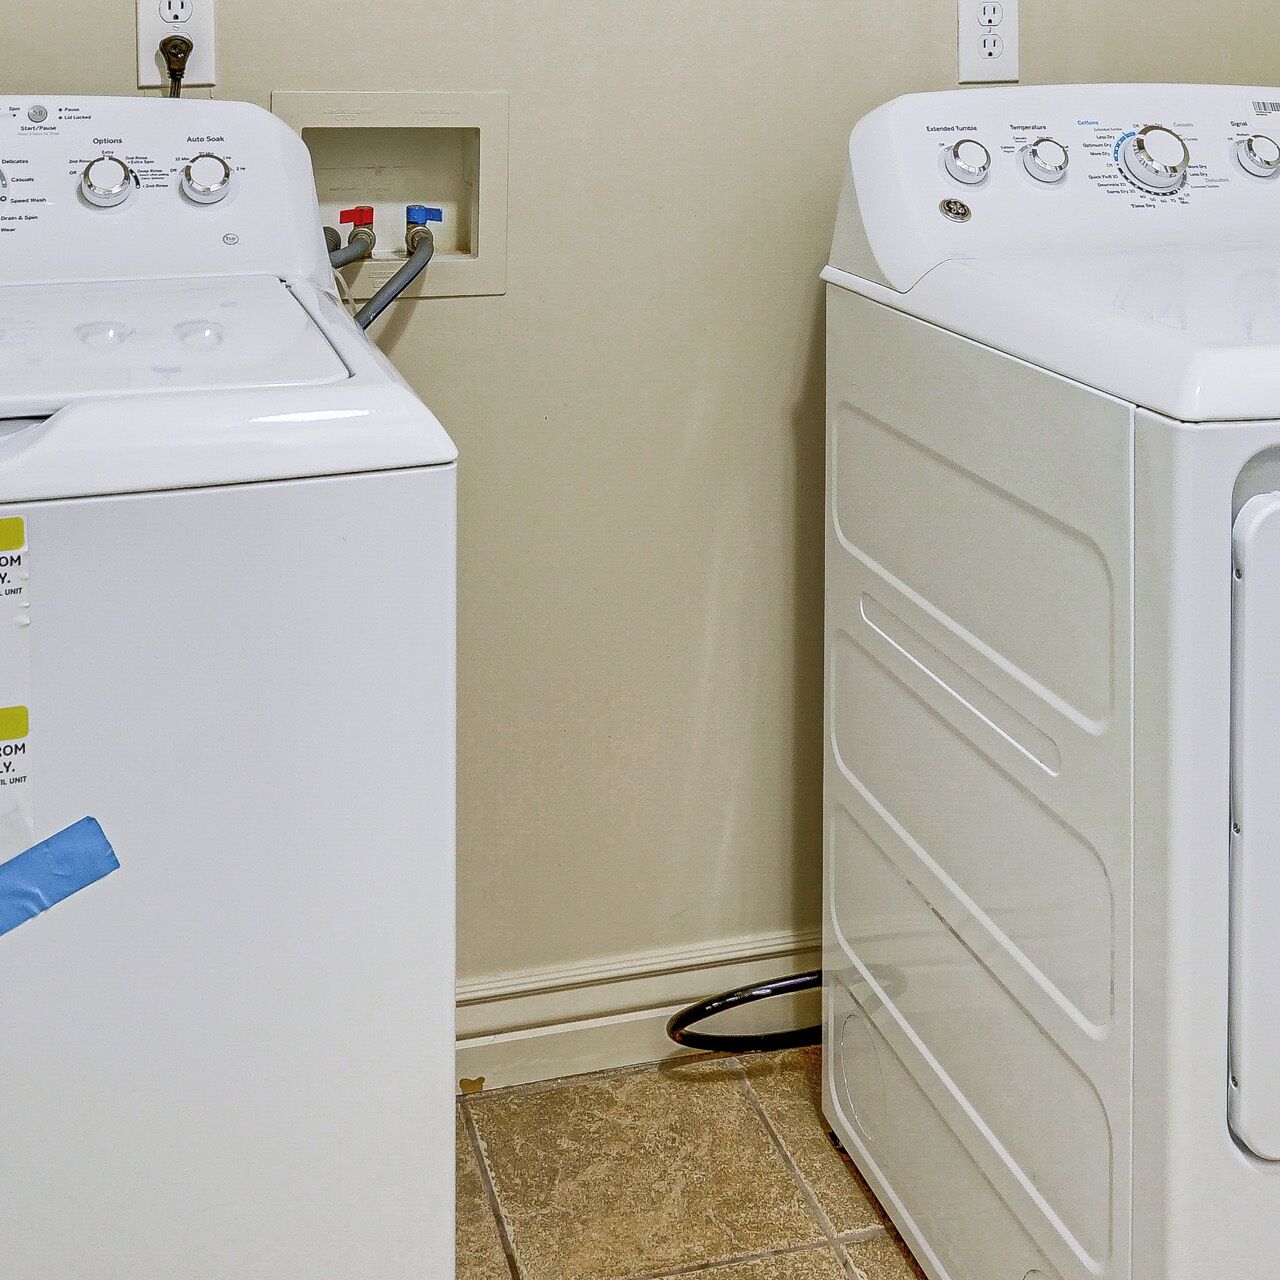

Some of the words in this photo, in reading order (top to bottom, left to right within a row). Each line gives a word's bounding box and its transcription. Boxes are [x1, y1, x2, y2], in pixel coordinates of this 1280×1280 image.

[92, 138, 123, 146] Options
[4, 588, 23, 597] UNIT
[9, 776, 27, 785] UNIT
